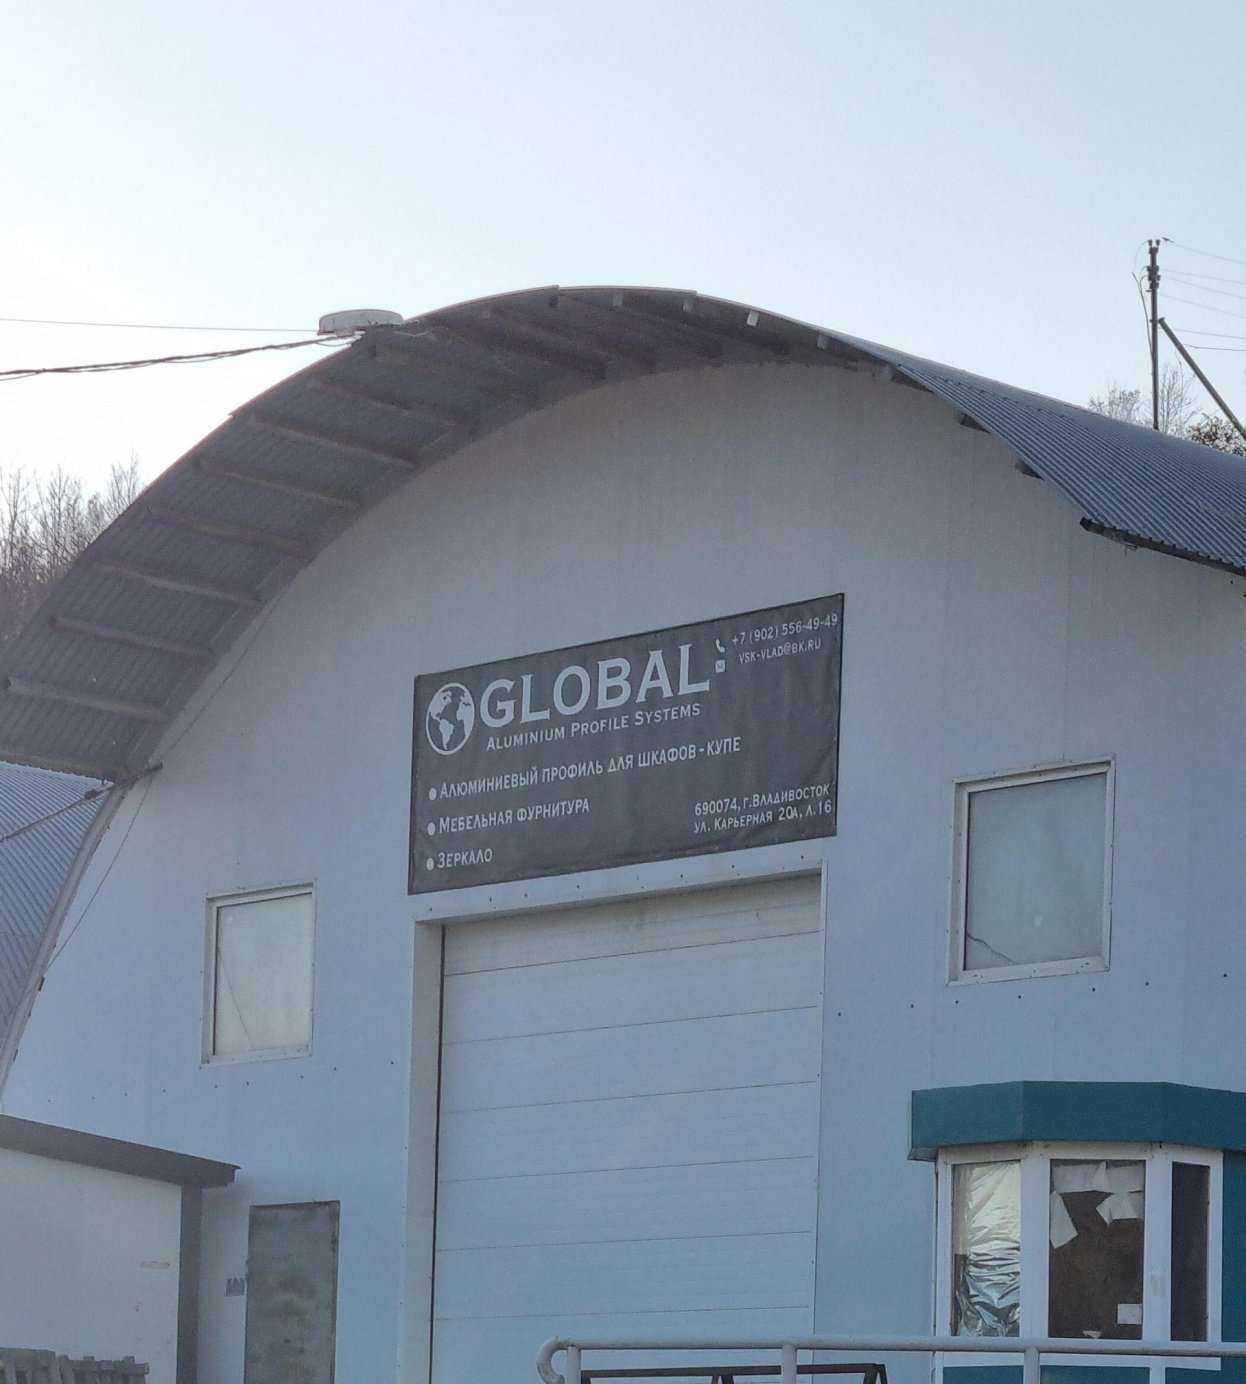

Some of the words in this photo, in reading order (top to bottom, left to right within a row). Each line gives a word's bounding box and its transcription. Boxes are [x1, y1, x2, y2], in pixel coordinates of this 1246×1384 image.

[732, 632, 746, 646] +7
[749, 626, 778, 643] (902)
[480, 643, 711, 728] GLOBAL
[486, 726, 565, 751] ALUMINIUM
[571, 715, 629, 737] PROFILE
[634, 703, 701, 726] SYSTEMS
[542, 759, 603, 784] ПРОФИЛЬ
[607, 754, 634, 774] ДЛЯ
[516, 798, 590, 822] ФУРНИТУРА
[818, 799, 832, 815] 16
[437, 848, 493, 869] ЗЕРКАЛО
